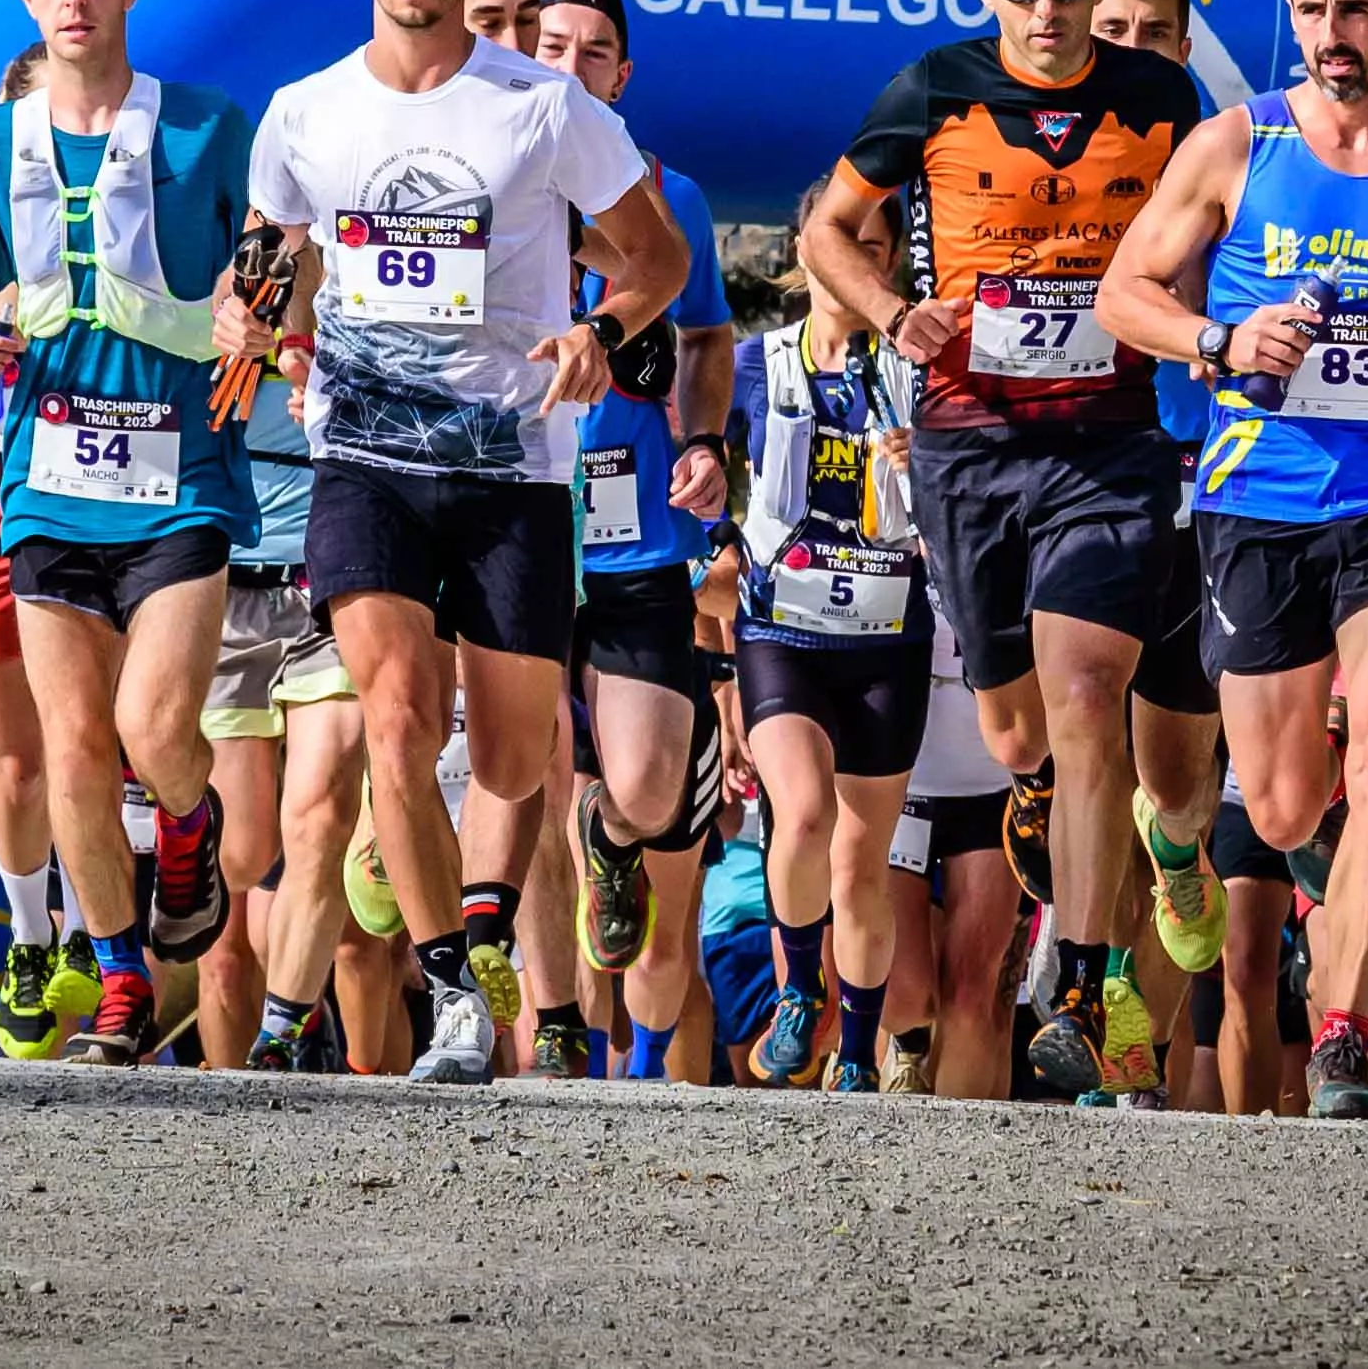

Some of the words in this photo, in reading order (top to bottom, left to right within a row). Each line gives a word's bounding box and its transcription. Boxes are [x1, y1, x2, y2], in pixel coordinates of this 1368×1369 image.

[372, 214, 467, 231] TRASCHINEPR
[386, 231, 425, 244] TRAIL
[427, 232, 461, 245] 2023
[972, 224, 1049, 241] TALLERES
[377, 249, 436, 288] 69
[1029, 294, 1067, 306] TRAIL
[1019, 312, 1078, 348] 27
[1026, 349, 1067, 360] SERGIO
[84, 412, 121, 427] TRAIL
[74, 429, 132, 469] 54
[82, 469, 119, 481] NACHO
[592, 463, 618, 476] 2023
[826, 557, 860, 572] TRAIL
[862, 560, 891, 574] 2023
[829, 574, 854, 607] 5
[819, 606, 860, 619] ANGELA
